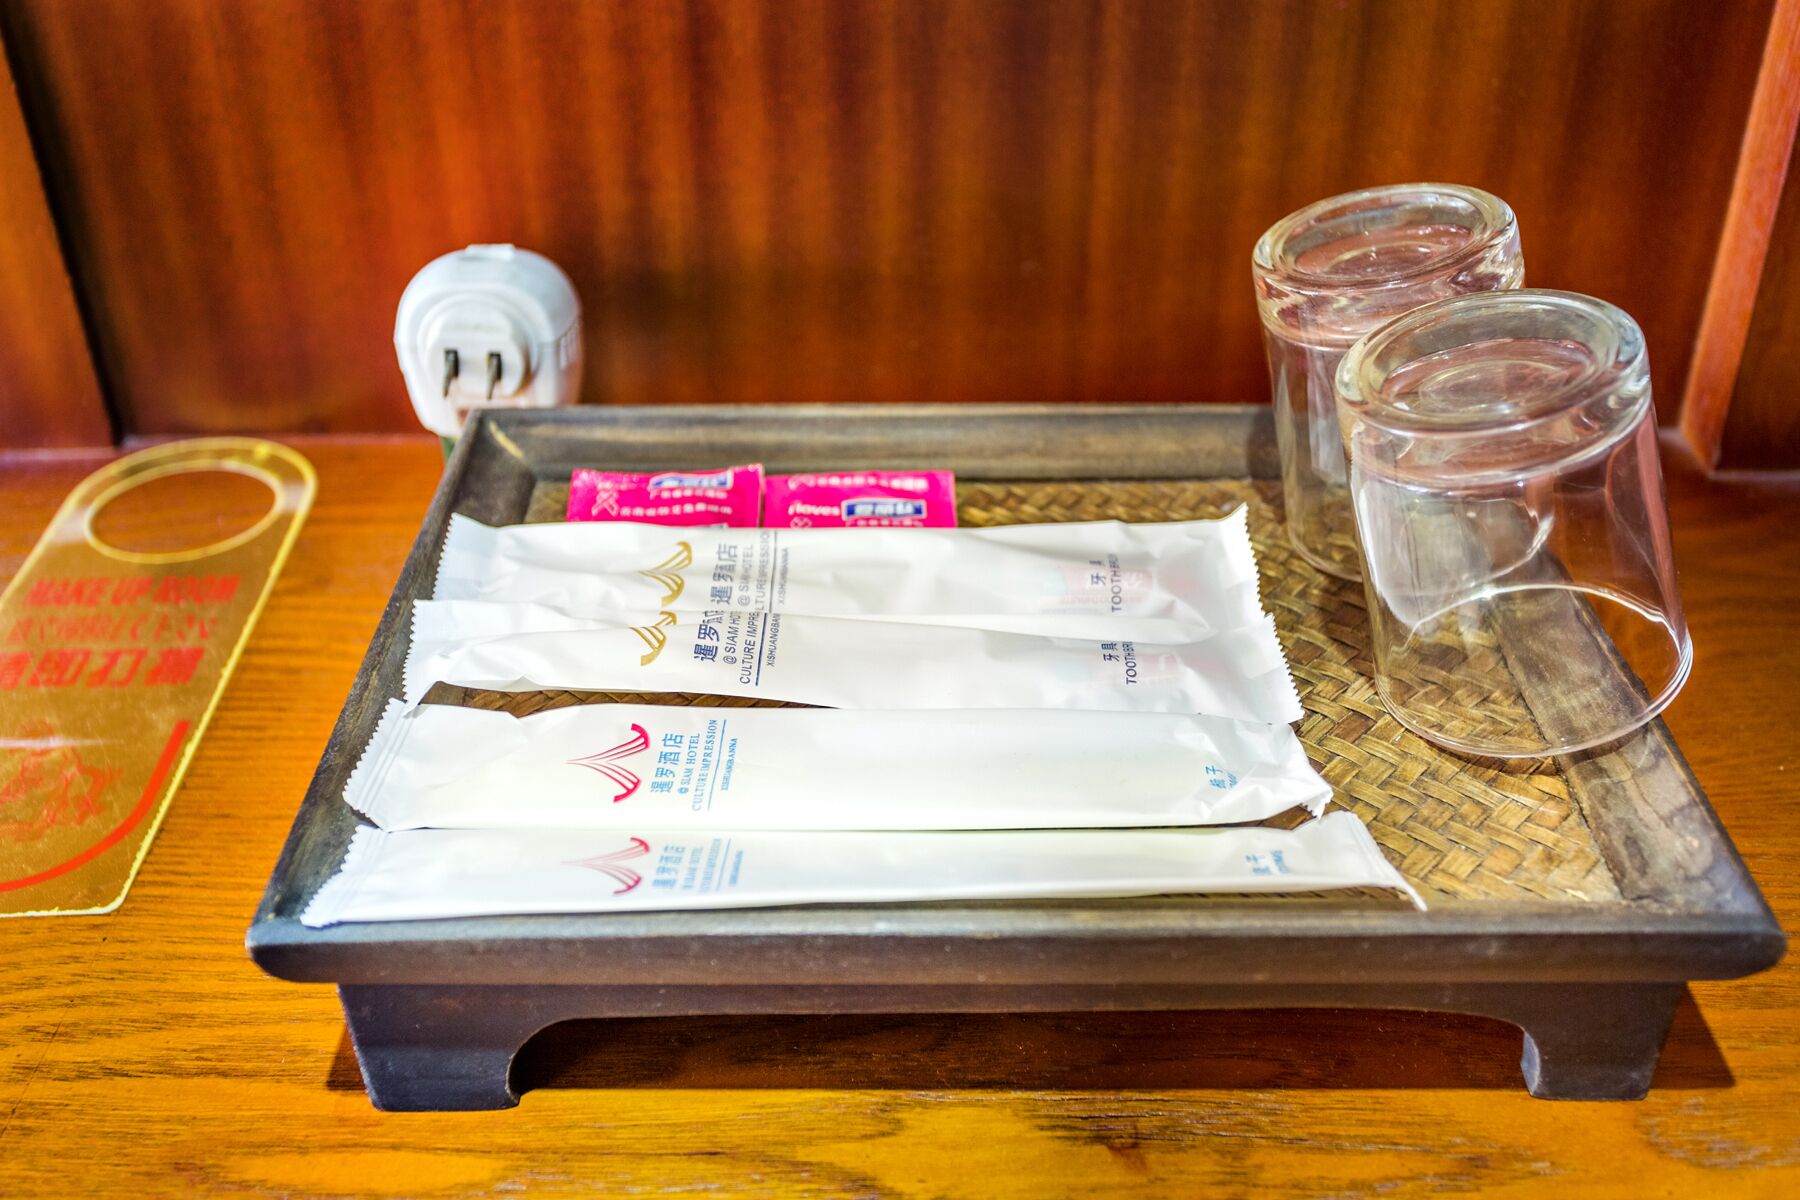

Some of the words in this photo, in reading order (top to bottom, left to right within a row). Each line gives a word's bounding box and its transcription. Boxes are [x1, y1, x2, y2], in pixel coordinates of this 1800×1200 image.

[724, 628, 739, 654] SIAM
[722, 655, 738, 666] @
[739, 638, 756, 685] CULTURE
[650, 732, 685, 793] 暹罗酒店
[685, 732, 701, 765] HOTEL
[691, 772, 708, 812] CULTURE
[701, 718, 719, 771] IMPRESSION
[680, 767, 695, 786] SIAM
